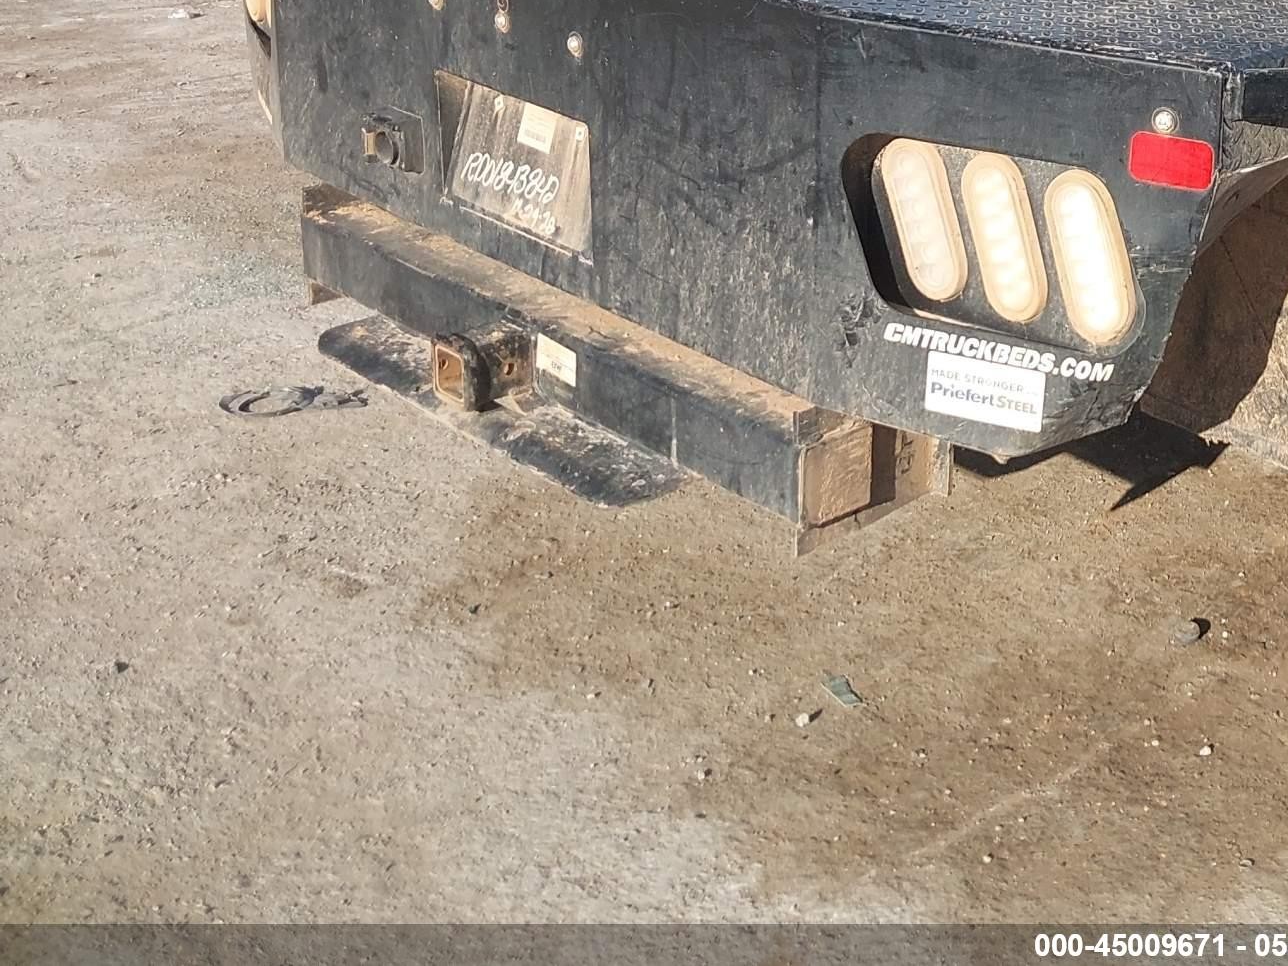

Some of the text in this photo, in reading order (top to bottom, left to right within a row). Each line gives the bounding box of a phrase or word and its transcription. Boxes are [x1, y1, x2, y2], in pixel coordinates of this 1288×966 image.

[884, 322, 1115, 382] CMTRUCKBEDS.COM
[931, 369, 961, 381] MADE
[964, 374, 1024, 393] STRONGER
